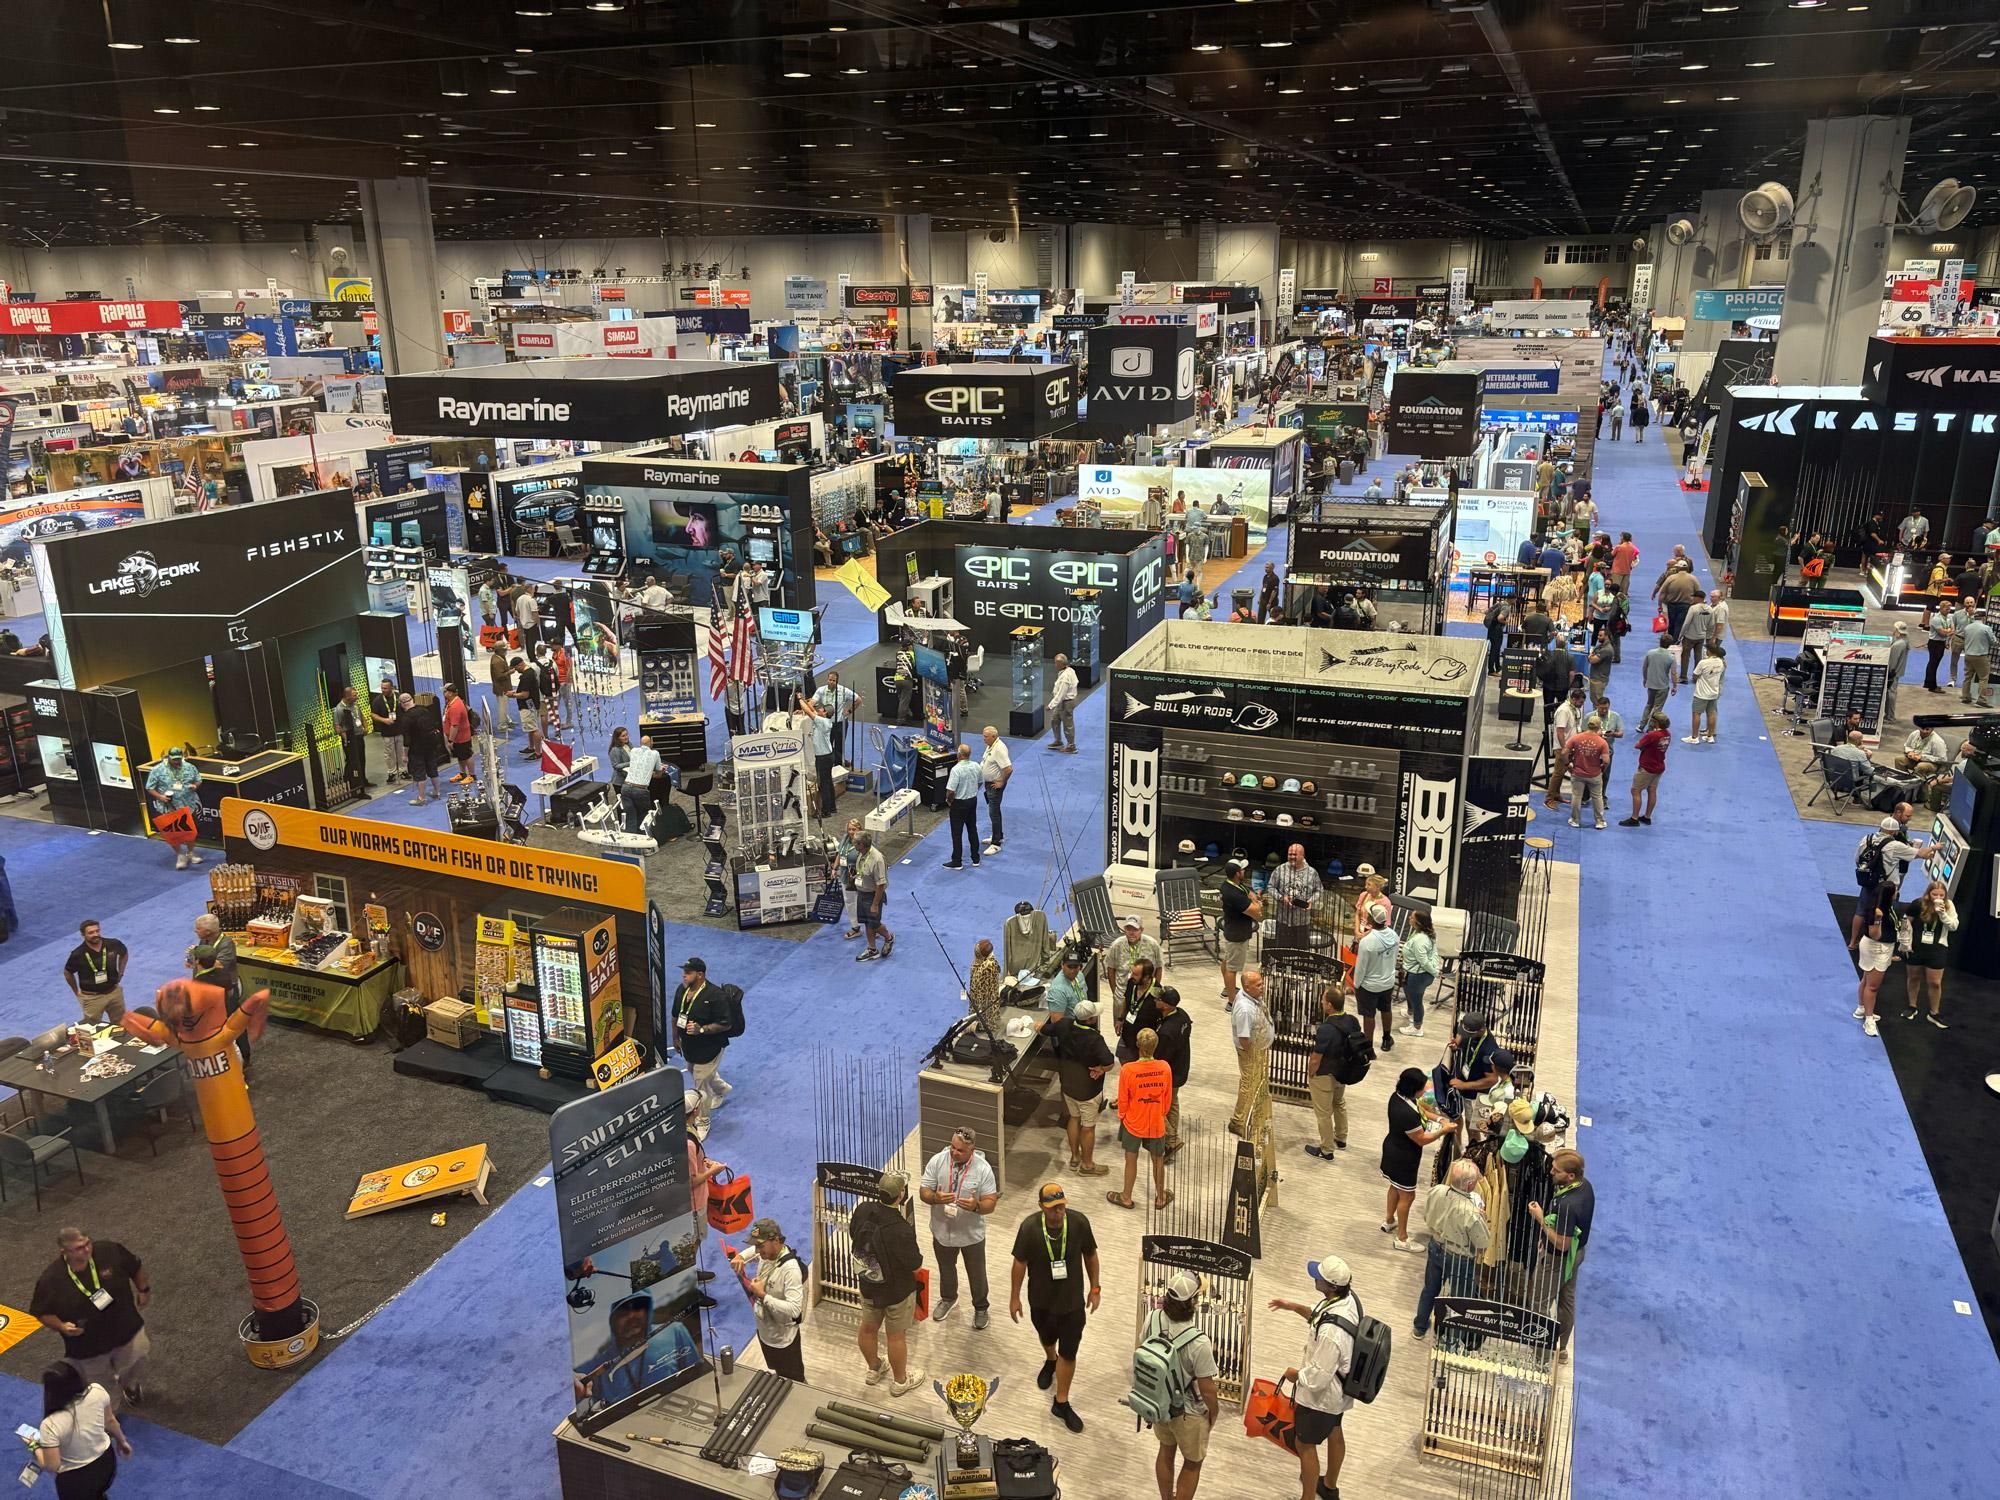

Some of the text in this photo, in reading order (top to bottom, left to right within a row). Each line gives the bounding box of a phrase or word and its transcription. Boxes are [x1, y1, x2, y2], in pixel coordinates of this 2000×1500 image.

[1361, 253, 1378, 261] EXIT
[856, 289, 897, 302] Scotty
[911, 289, 929, 302] Scotty
[223, 316, 243, 326] SFC
[1901, 306, 1922, 321] 60
[520, 336, 551, 346] SIMRAD
[607, 331, 636, 342] SIMRAD
[1485, 381, 1550, 389] AMERICAN-OWNED.
[1486, 374, 1537, 382] VETERAN-BUILT.
[925, 386, 1005, 414] EPIC
[1045, 376, 1070, 406] EPIC
[1093, 385, 1173, 401] AVID
[438, 397, 570, 426] Raymarine
[667, 386, 749, 420] Raymarine
[1399, 406, 1463, 415] FOUNDATION
[941, 416, 992, 426] BAITS
[644, 468, 721, 486] Raymarine
[1086, 485, 1121, 495] AVID
[16, 503, 81, 520] GLOBAL SALES
[247, 529, 345, 561] FISHSTIX
[1320, 550, 1400, 563] FOUNDATION
[89, 561, 200, 595] LAKE FORK
[965, 556, 1031, 582] EPIC
[1049, 561, 1119, 587] EPIC
[119, 579, 173, 596] ROD CO.
[977, 580, 1018, 590] BAITS
[1132, 556, 1163, 604] EPIC
[773, 611, 799, 623] EMS
[974, 601, 1103, 624] BE EPIC TODAY
[1137, 597, 1156, 619] BAITS
[1348, 656, 1421, 674] Bull Bay Rods
[33, 697, 57, 707] LAKE
[34, 704, 58, 714] FORK
[1154, 702, 1233, 719] BULL BAY RODS
[1296, 716, 1319, 724] FEEL
[1337, 720, 1392, 730] DIFFERENCE
[1399, 725, 1422, 733] FEEL
[1441, 728, 1463, 736] BITE
[739, 740, 797, 758] MATE Series
[1111, 793, 1119, 828] TACKLE
[1397, 772, 1410, 863] BULL BAY TACKLE
[249, 821, 271, 837] DMF
[1462, 835, 1491, 844] FEEL
[320, 826, 598, 893] OUR WORMS CATCH FISH OR DIE TRYING!
[417, 921, 441, 936] DMF
[588, 950, 617, 983] LIVE
[590, 960, 617, 995] BAIT
[292, 983, 311, 993] CATCH
[313, 987, 326, 997] FISH
[608, 1041, 635, 1066] LIVE
[612, 1053, 638, 1077] BAIT
[561, 1094, 661, 1164] SNIPER
[602, 1113, 677, 1169] ELITE
[570, 1157, 676, 1206] ELITE PERFORMANCE.
[571, 1169, 676, 1217] UNMATCHED UNREAL
[612, 1189, 650, 1208] UNLEASHED
[591, 1212, 664, 1247] www.bullbayrods.com
[598, 1221, 615, 1235] NOW
[1465, 1312, 1482, 1322] BULL
